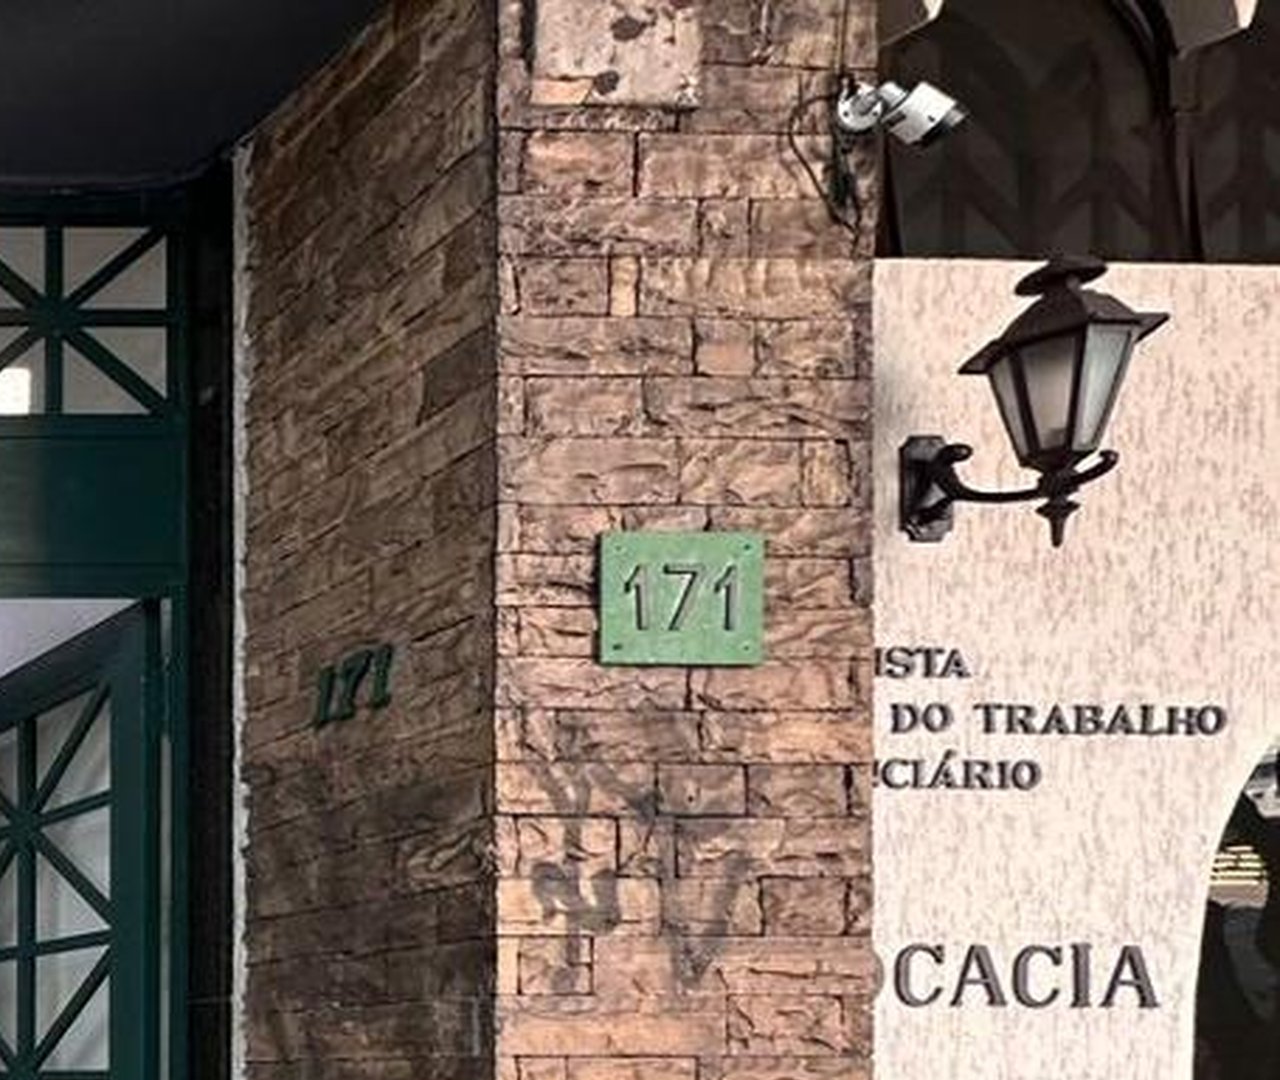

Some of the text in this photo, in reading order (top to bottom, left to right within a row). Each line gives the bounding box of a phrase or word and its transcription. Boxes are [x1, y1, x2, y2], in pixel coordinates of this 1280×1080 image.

[624, 562, 737, 632] 171
[317, 643, 393, 726] 171
[890, 703, 1228, 737] DO TRABALHO
[894, 943, 1160, 1009] CACIA
